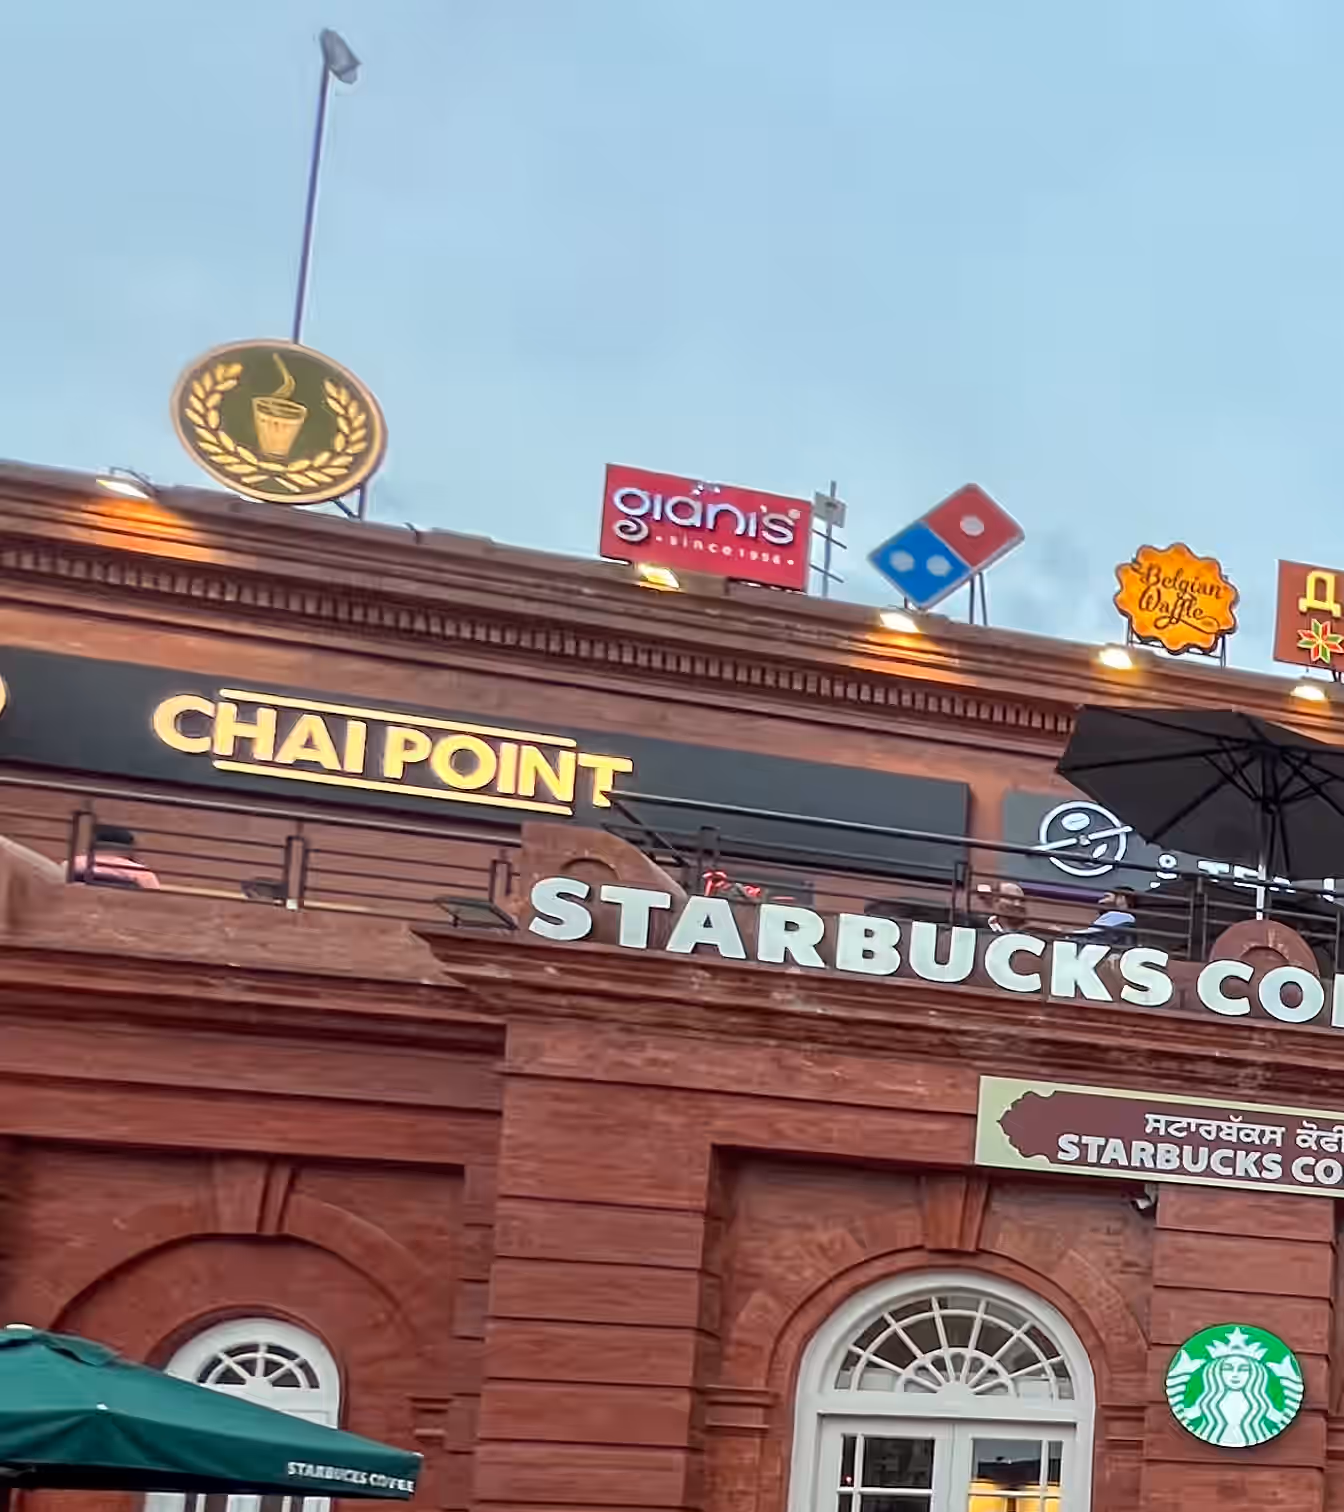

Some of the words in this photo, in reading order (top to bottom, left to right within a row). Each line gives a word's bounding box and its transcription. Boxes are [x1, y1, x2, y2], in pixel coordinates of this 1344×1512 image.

[669, 533, 732, 556] since
[1138, 562, 1223, 601] Belgian
[1138, 586, 1221, 635] Waffle
[153, 693, 368, 774] CHAI
[383, 724, 634, 809] POINT
[529, 876, 1174, 1008] STARBUCKS
[1057, 1133, 1283, 1181] STARBUCKS
[287, 1461, 368, 1484] STARBUCKS
